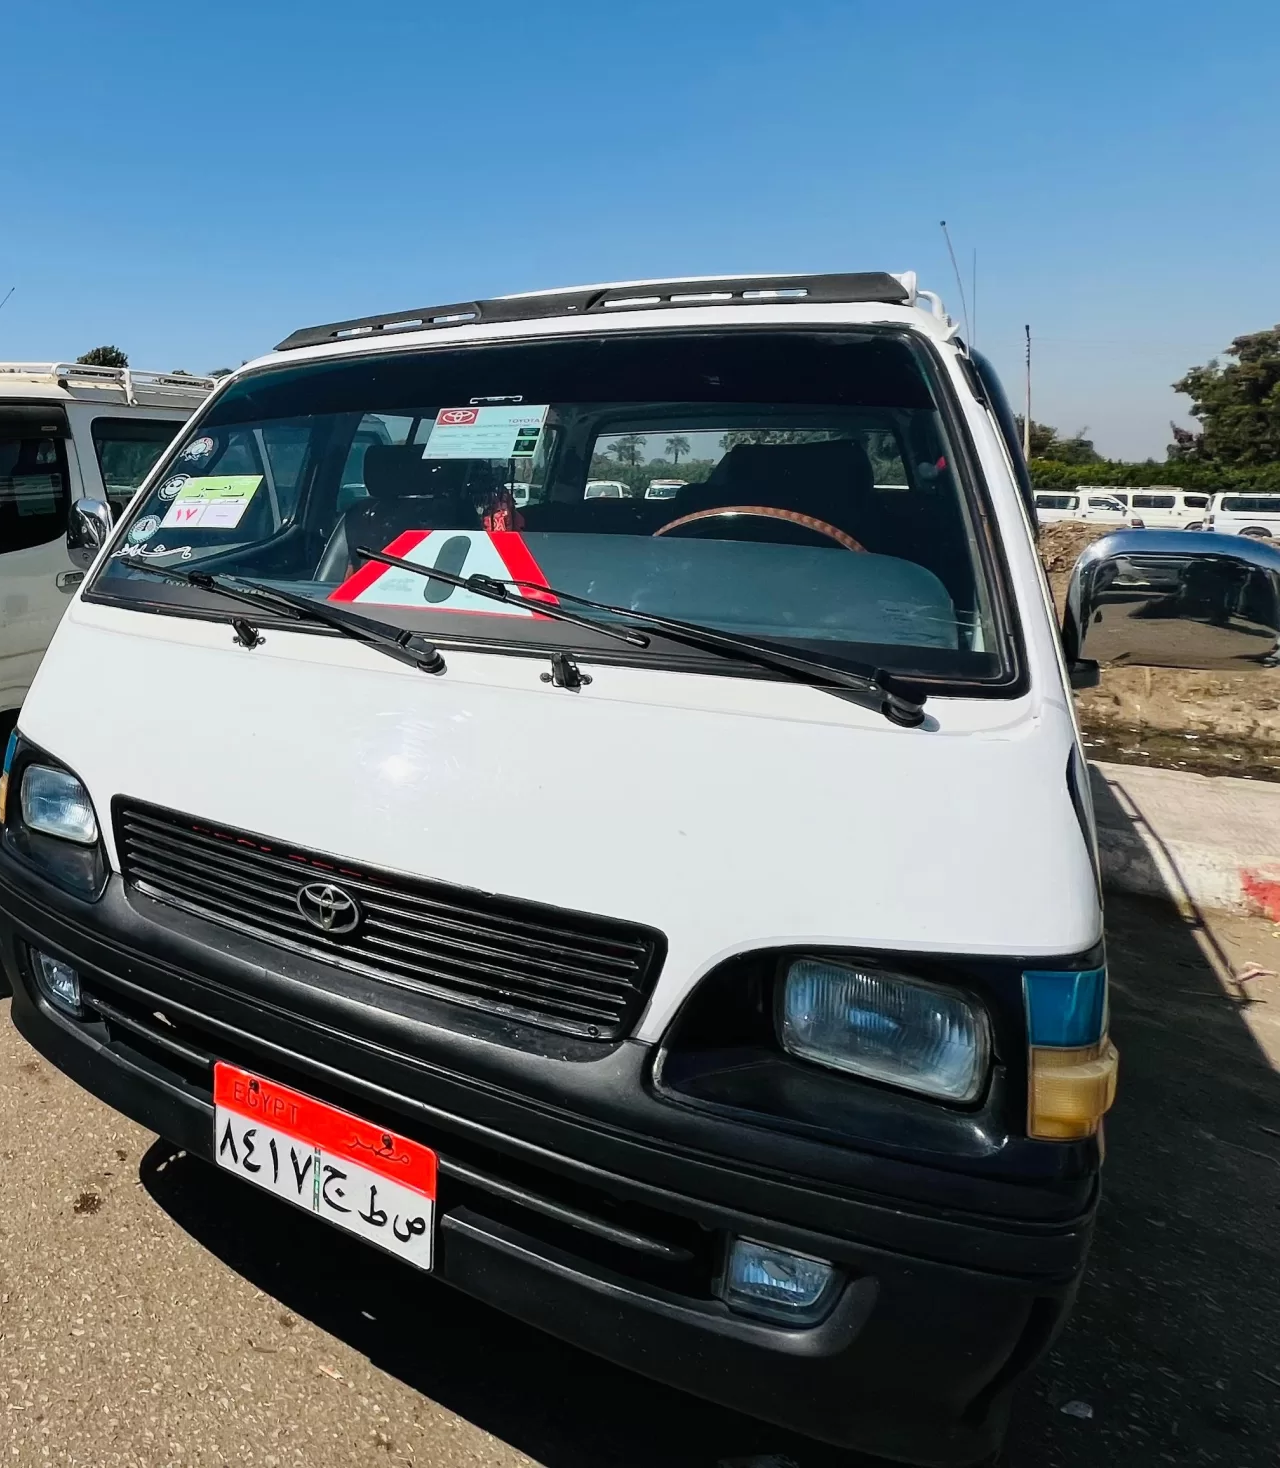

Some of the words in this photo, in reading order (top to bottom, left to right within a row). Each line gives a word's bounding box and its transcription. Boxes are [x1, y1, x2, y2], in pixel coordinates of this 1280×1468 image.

[508, 417, 542, 425] TOYOTA
[233, 1080, 299, 1125] EGYPT
[219, 1118, 313, 1196] ٨٤١٧
[347, 1134, 410, 1165] مصر
[322, 1164, 352, 1214] ج
[357, 1184, 389, 1228] ط
[392, 1213, 427, 1243] ص
